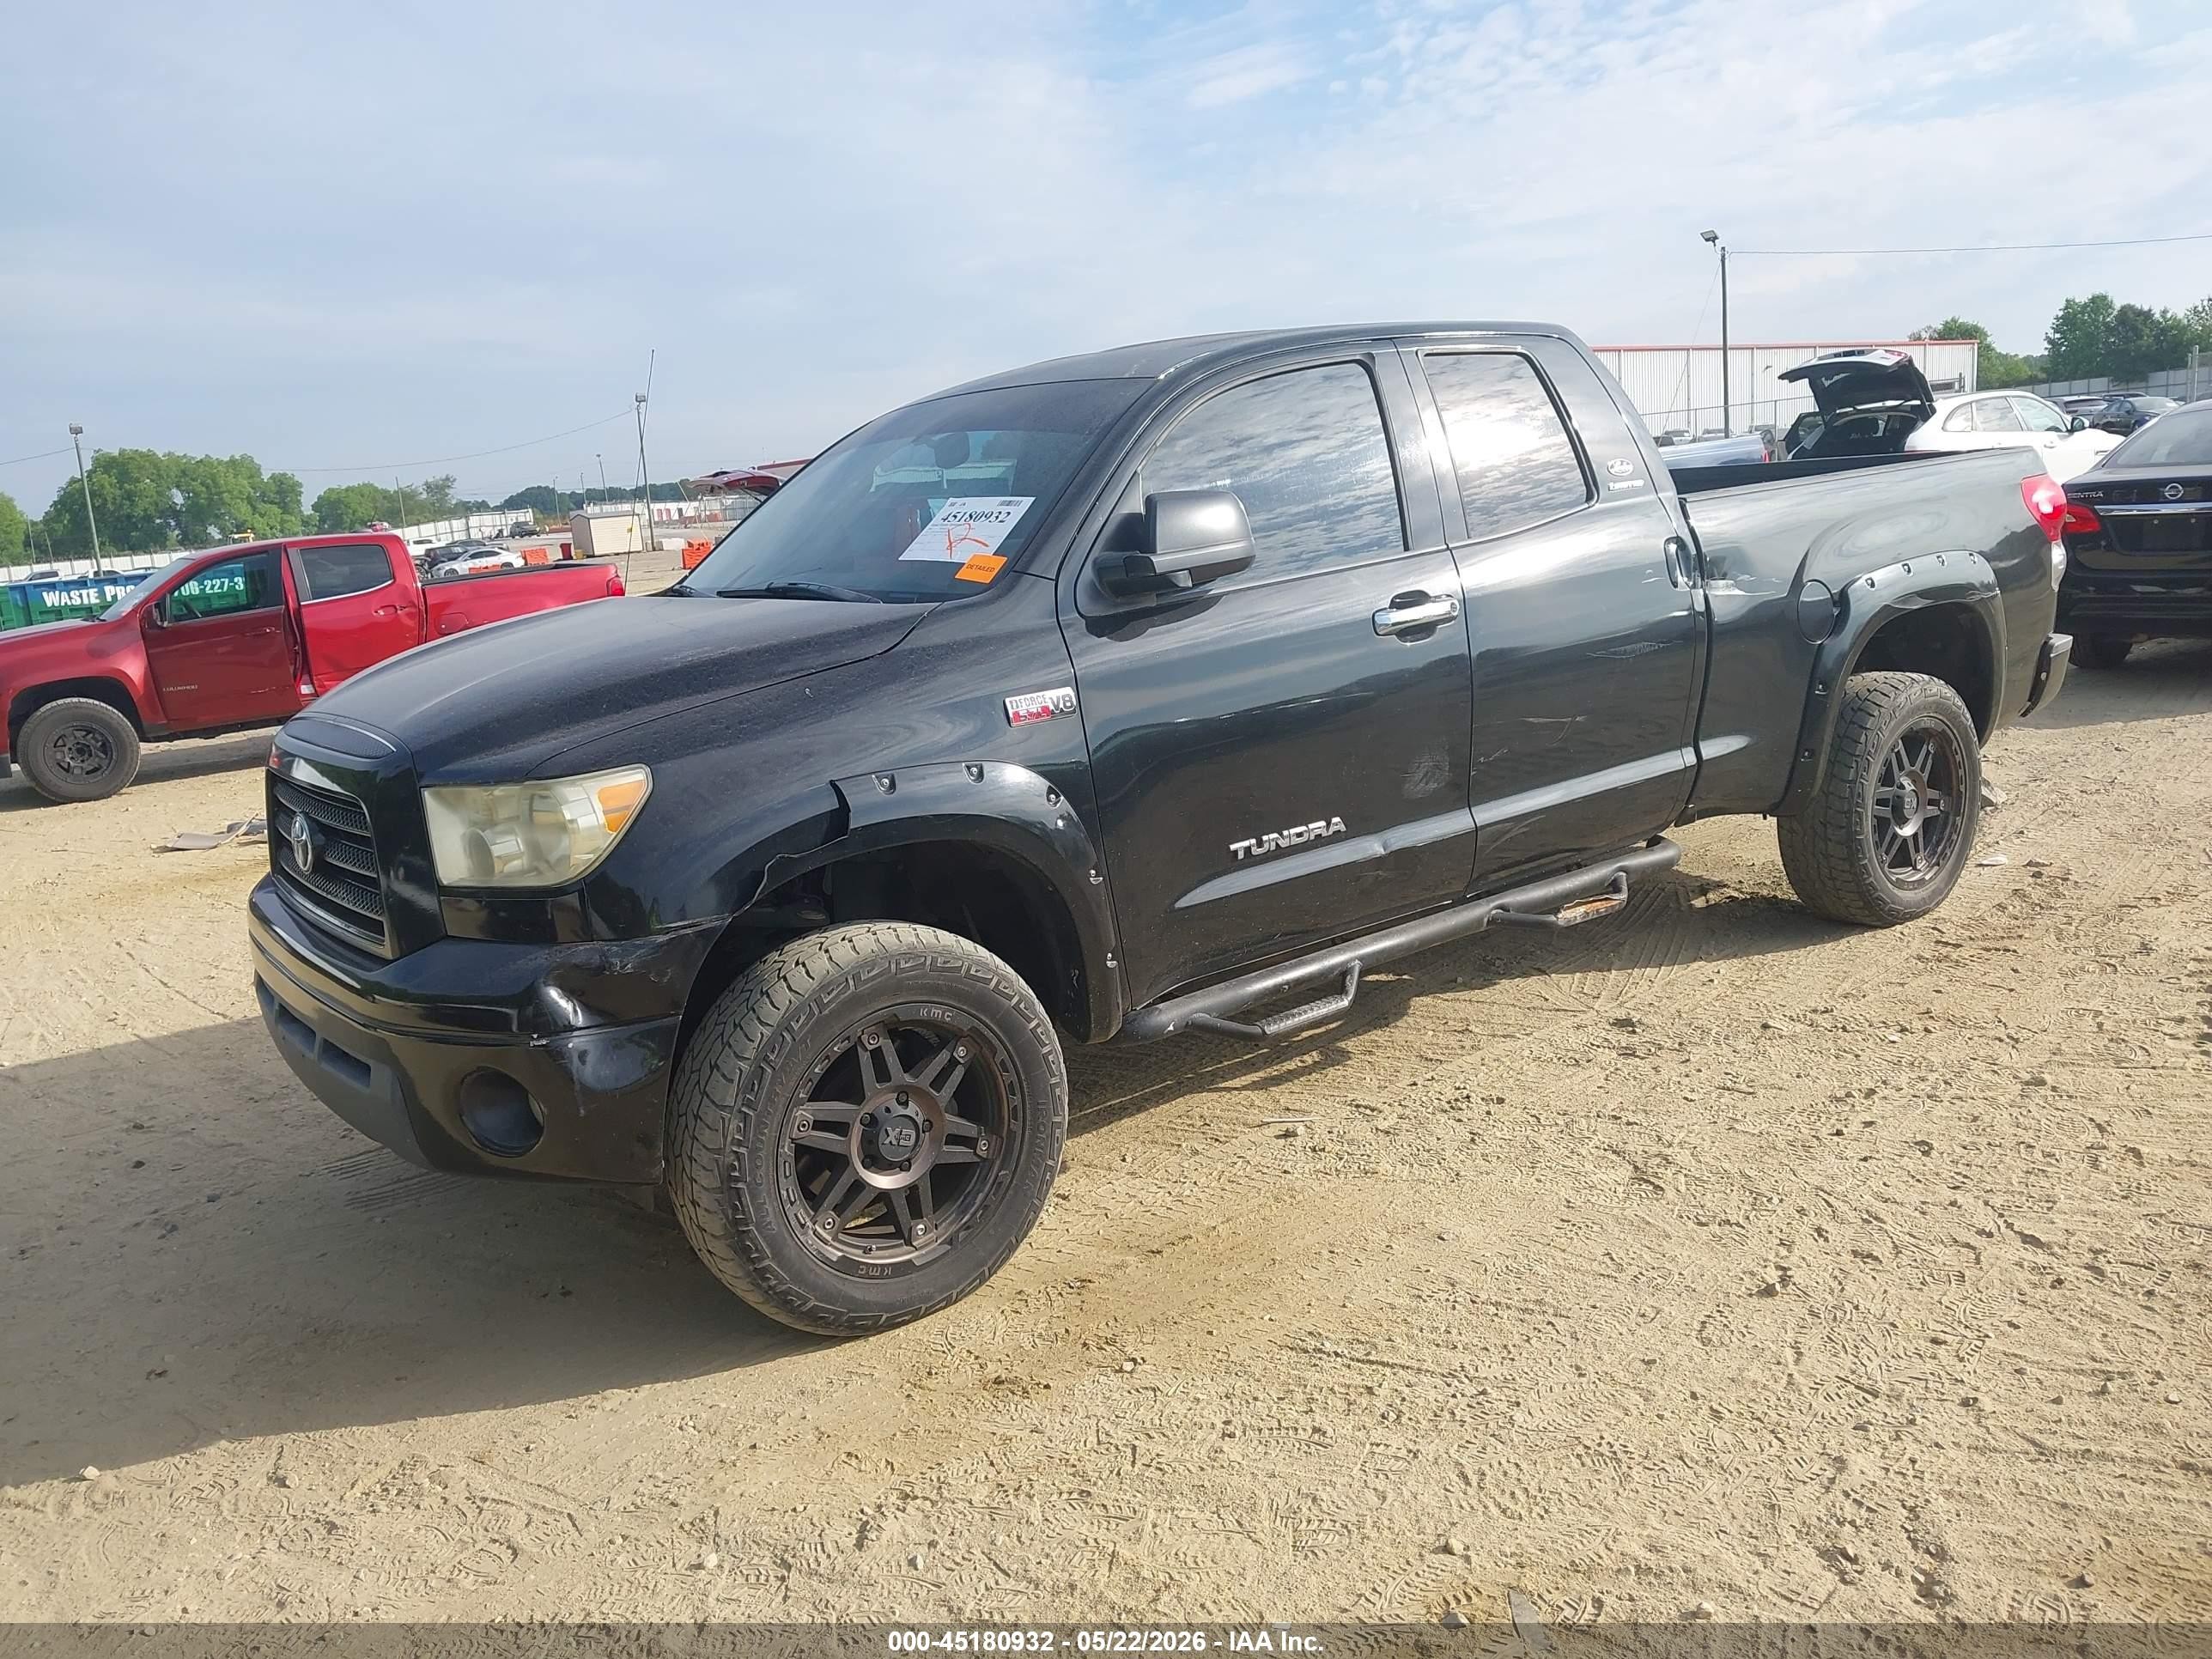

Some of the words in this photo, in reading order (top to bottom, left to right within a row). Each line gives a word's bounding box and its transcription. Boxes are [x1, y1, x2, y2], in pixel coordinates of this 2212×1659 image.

[941, 510, 1012, 523] 45180932
[966, 563, 996, 573] DETAILED
[42, 587, 100, 607] WASTE
[1229, 816, 1347, 860] TUNDRA
